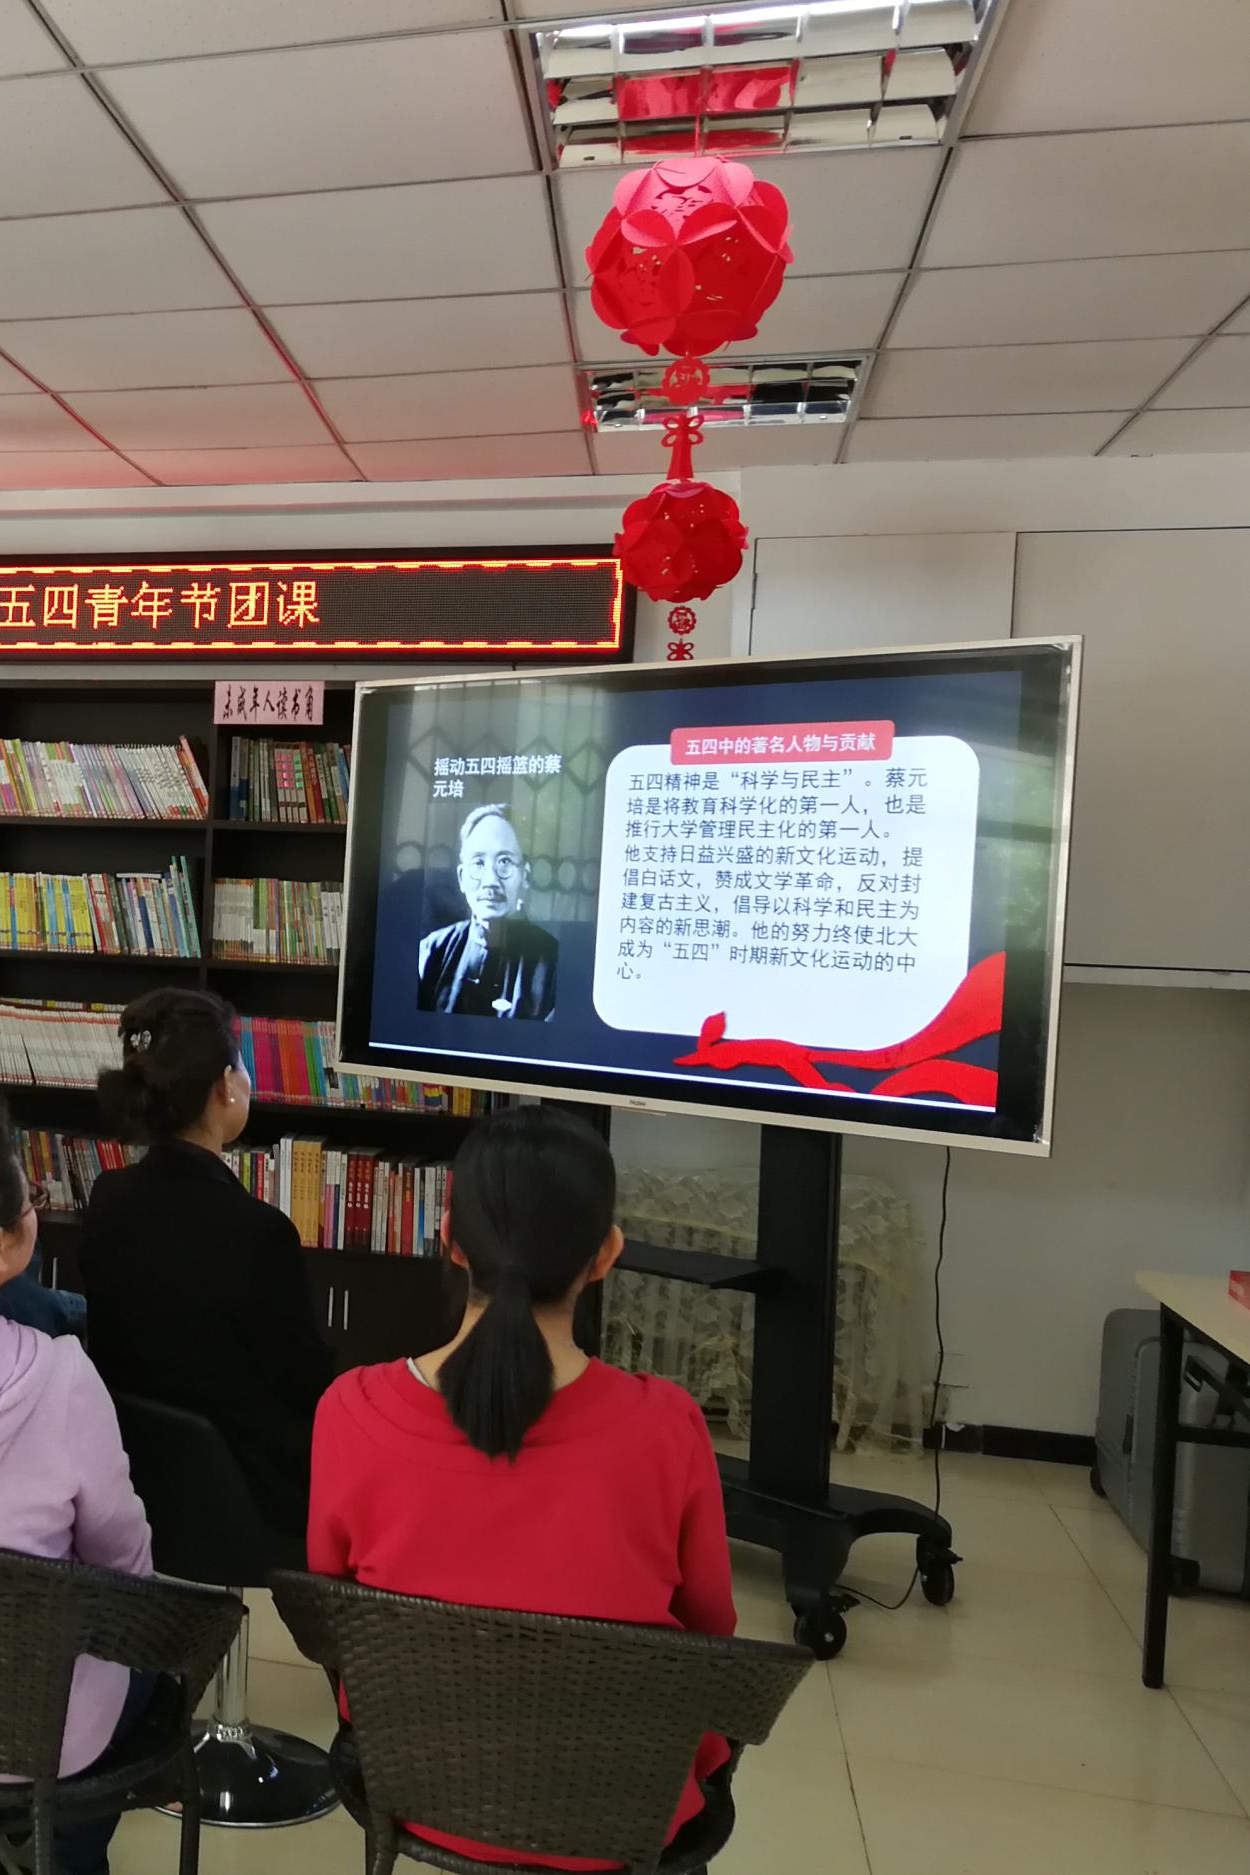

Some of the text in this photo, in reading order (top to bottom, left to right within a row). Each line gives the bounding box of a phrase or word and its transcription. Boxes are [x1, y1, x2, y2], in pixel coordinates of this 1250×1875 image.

[686, 733, 876, 755] 五四中的著名人物与贡献
[434, 754, 563, 776] 摇动五四摇篮的蔡
[433, 780, 464, 798] 元培
